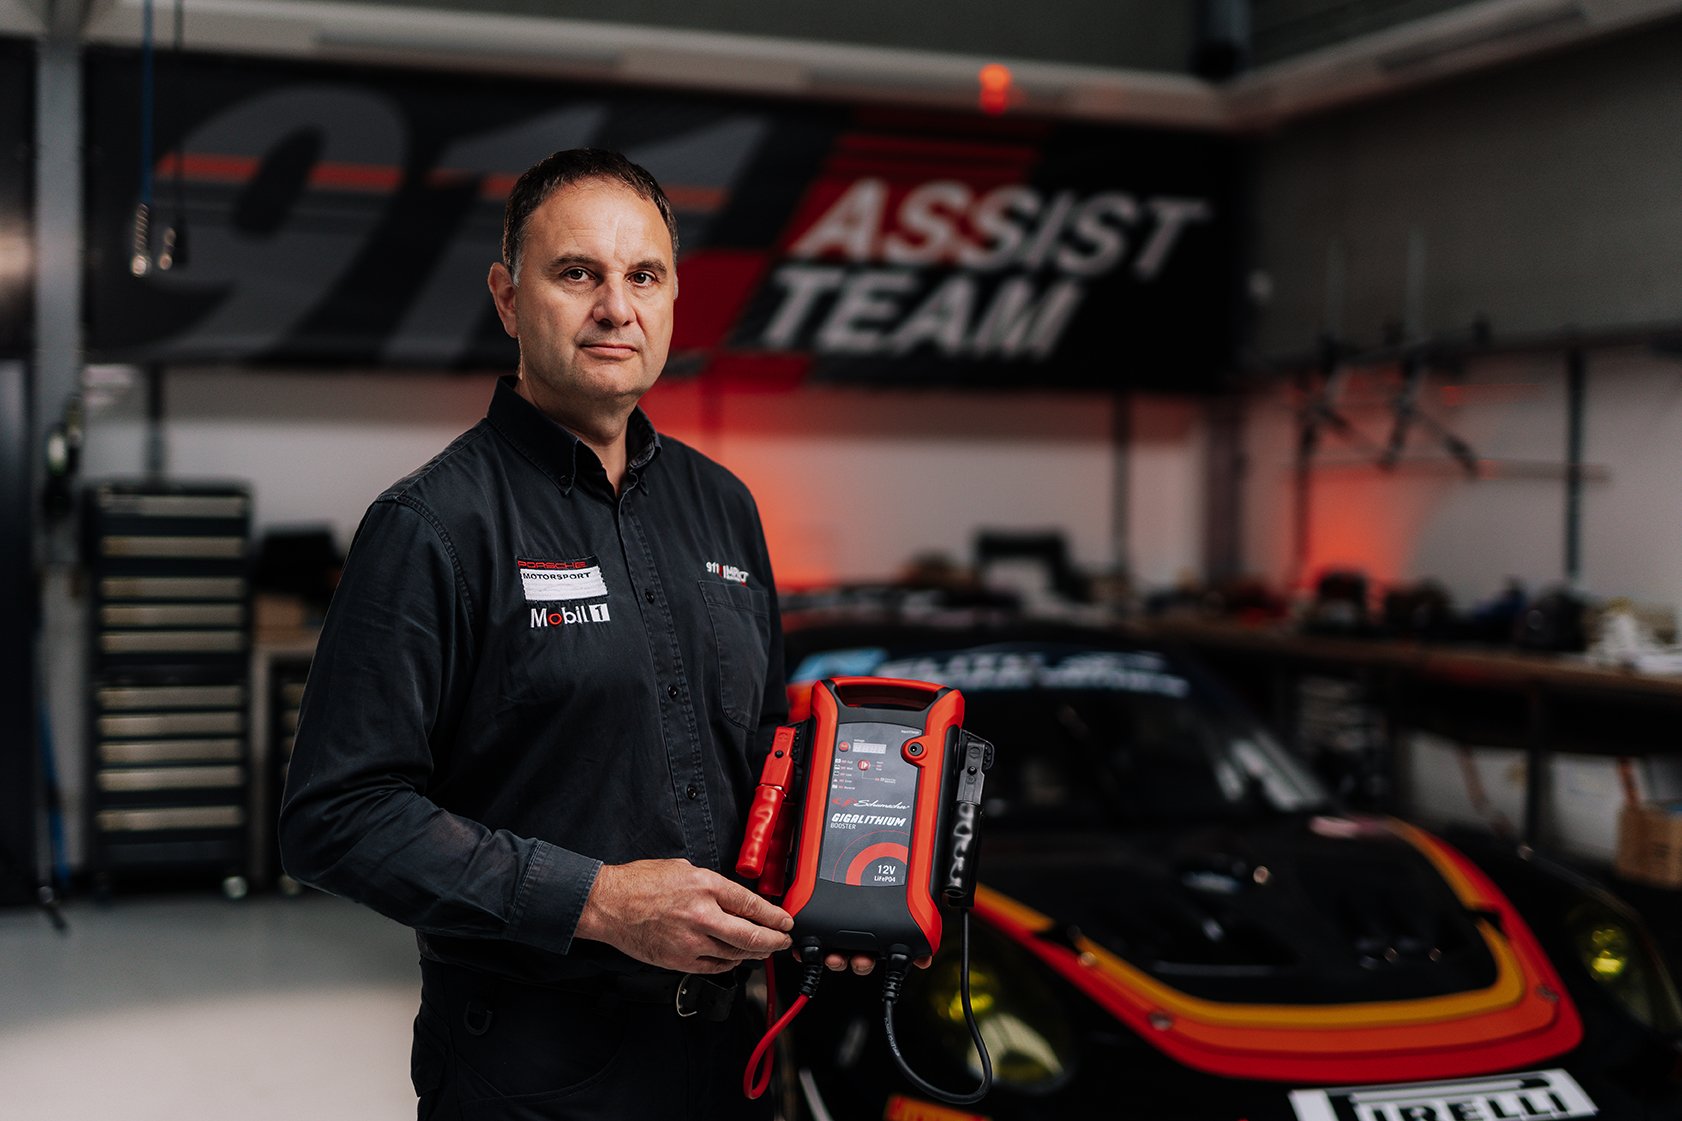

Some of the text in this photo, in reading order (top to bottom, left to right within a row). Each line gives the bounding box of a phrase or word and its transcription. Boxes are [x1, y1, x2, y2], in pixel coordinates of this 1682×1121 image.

[788, 178, 1210, 279] ASSIST
[761, 265, 1083, 358] TEAM
[517, 560, 587, 569] PORSCHE
[705, 561, 720, 574] 911
[523, 572, 591, 580] MOTORSPORT
[530, 605, 589, 628] Mobil
[830, 822, 856, 830] BOOSTER
[831, 813, 907, 827] GIGALITHIUM
[877, 864, 896, 875] 12V
